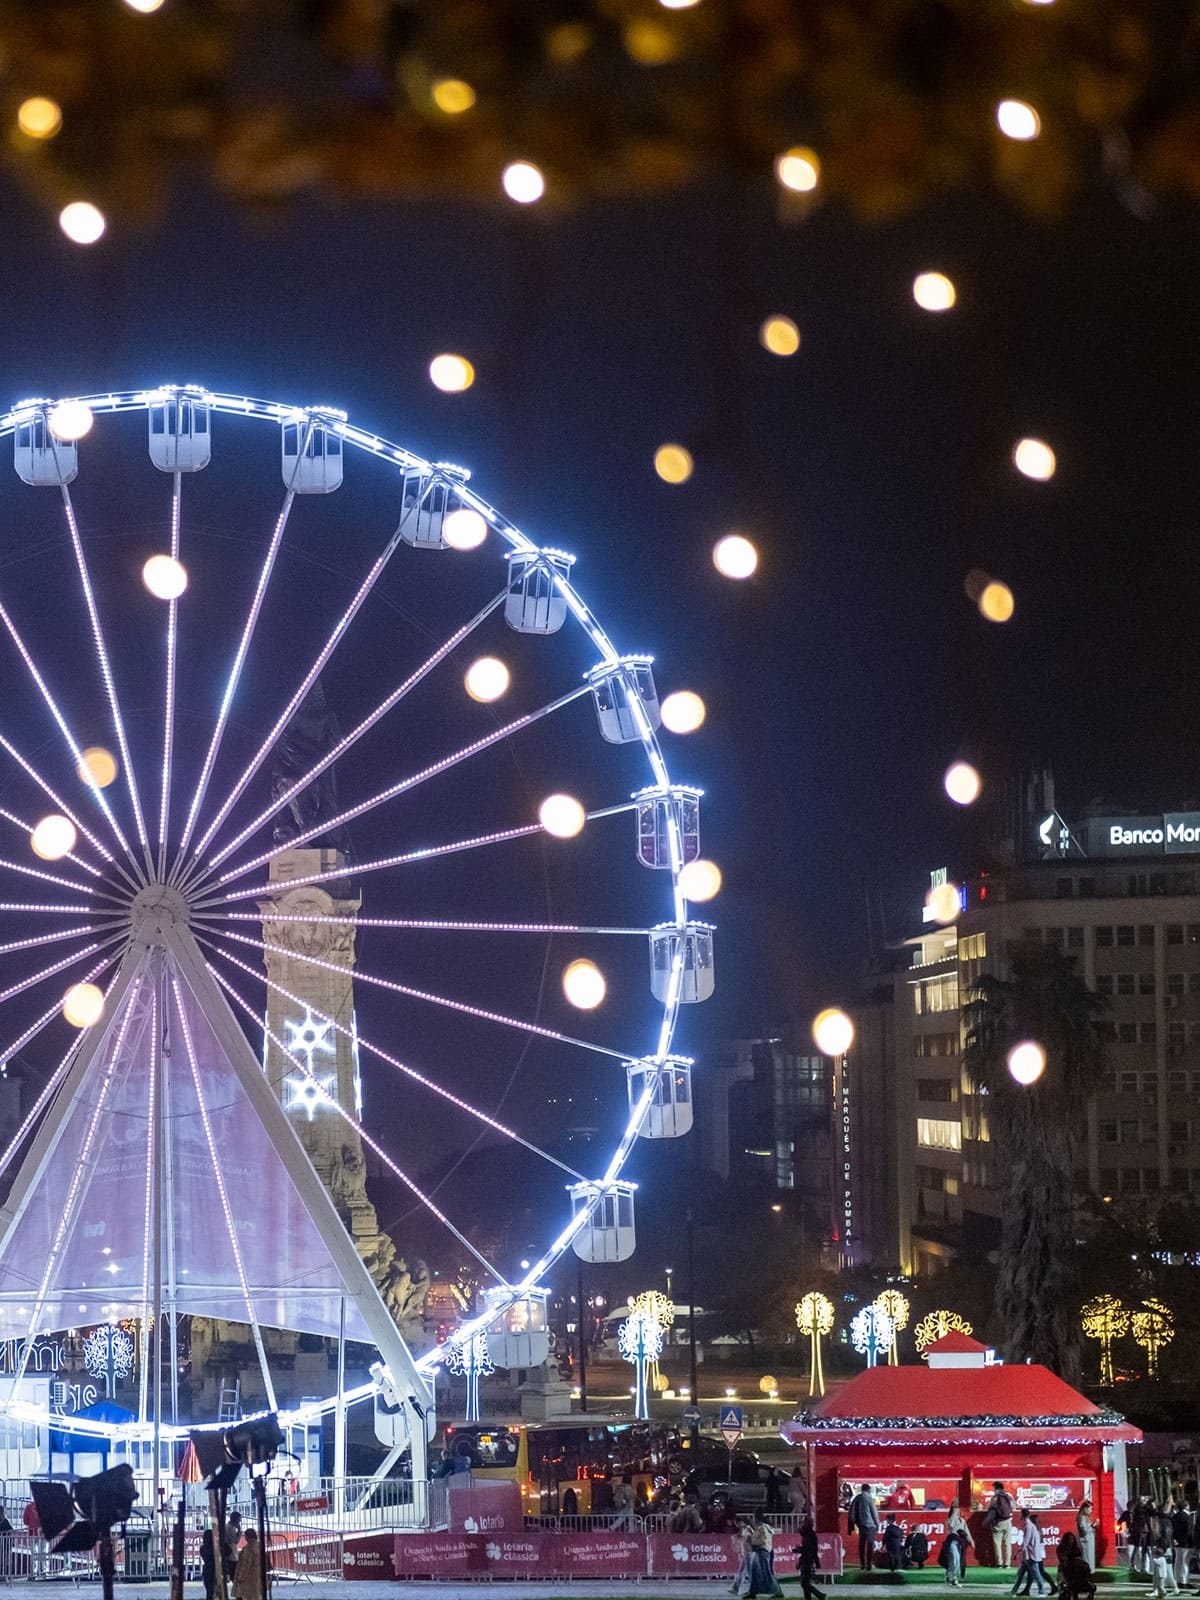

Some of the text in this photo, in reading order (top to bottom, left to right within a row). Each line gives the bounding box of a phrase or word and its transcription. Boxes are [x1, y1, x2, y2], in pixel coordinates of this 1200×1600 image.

[1110, 826, 1163, 845] Banco
[844, 1162, 850, 1180] DE
[844, 1191, 852, 1247] POMBAL
[480, 1515, 504, 1530] lotaria
[503, 1543, 533, 1551] lotaria
[691, 1544, 721, 1553] lotaria
